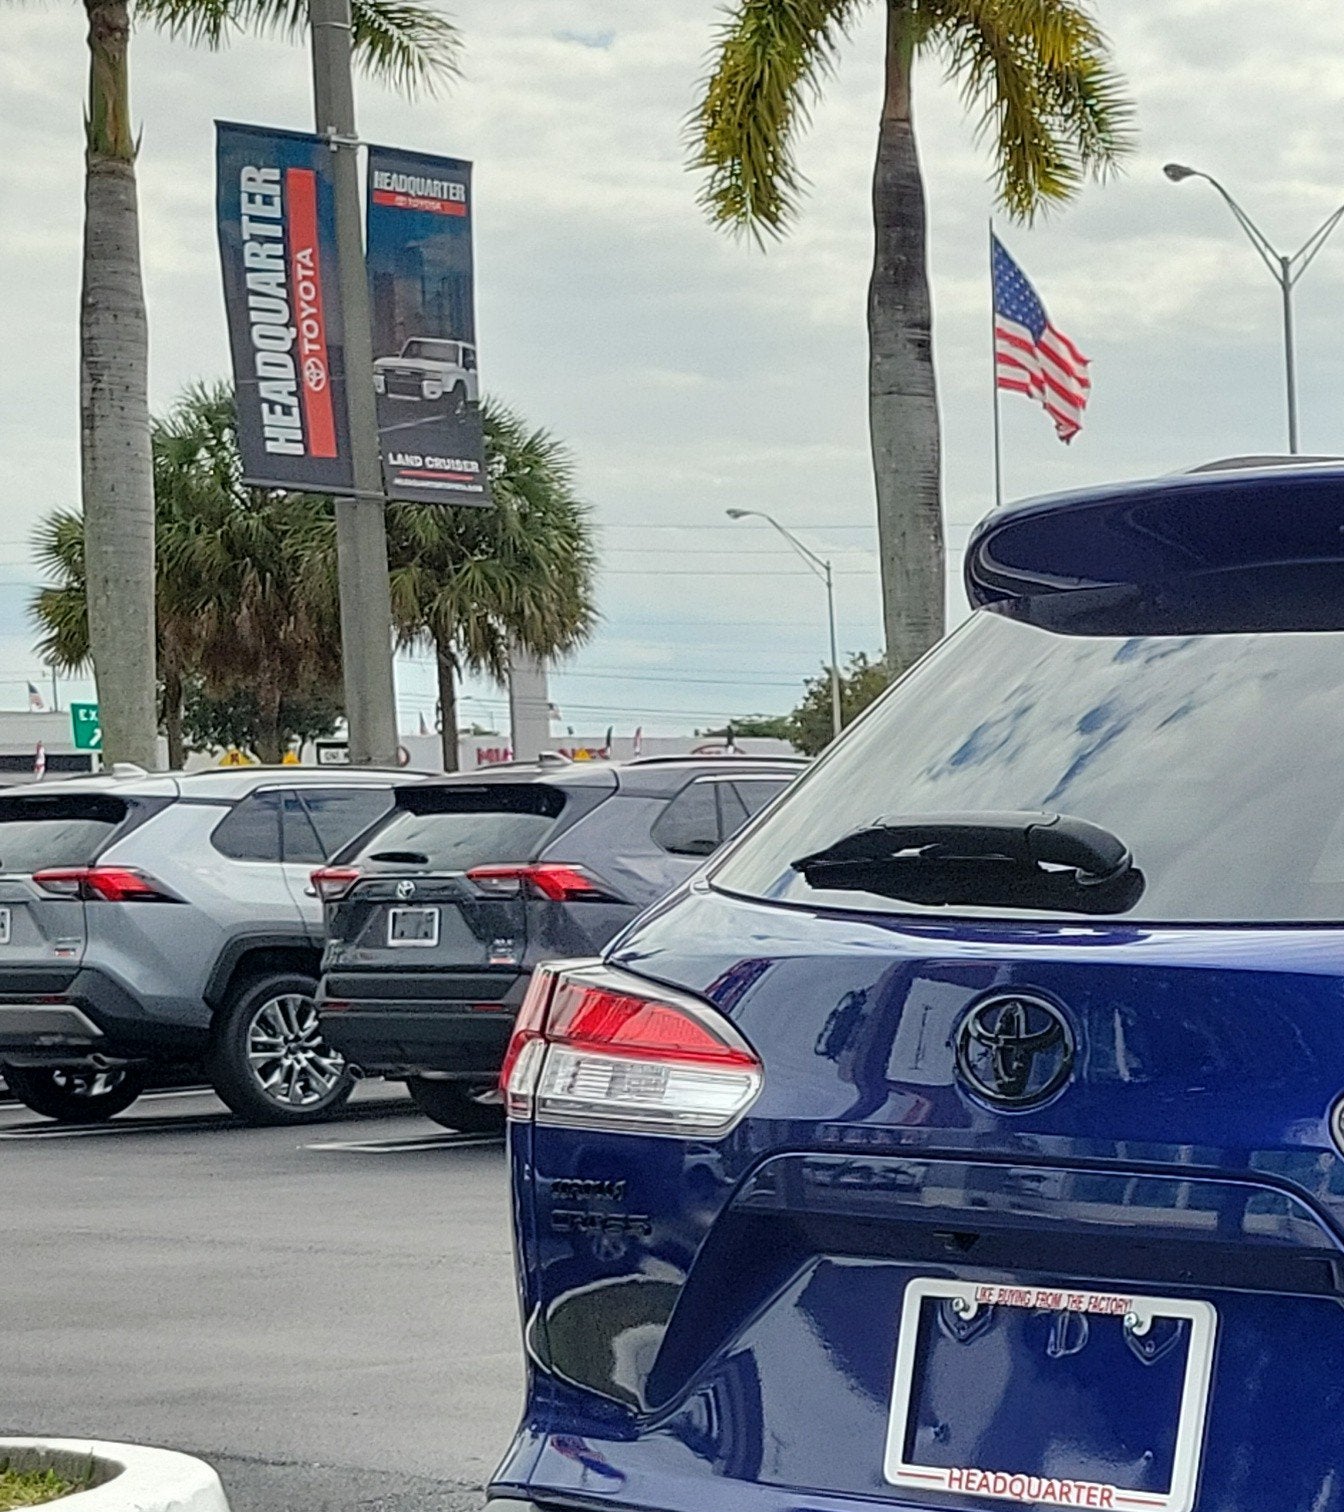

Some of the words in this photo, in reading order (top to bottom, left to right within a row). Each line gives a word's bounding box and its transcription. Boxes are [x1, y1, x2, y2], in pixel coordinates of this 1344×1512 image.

[373, 170, 466, 202] HEADQUARTER
[240, 165, 305, 456] HEADQUARTER
[296, 247, 321, 355] TOYOTA
[387, 452, 423, 468] LAND
[424, 456, 480, 473] CRUISER
[79, 708, 99, 721] EX
[976, 1286, 994, 1304] LIKE
[997, 1288, 1032, 1308] BUYING
[1035, 1291, 1063, 1310] FROM
[1066, 1294, 1085, 1312] THE
[947, 1468, 1115, 1508] HEADQUARTER
